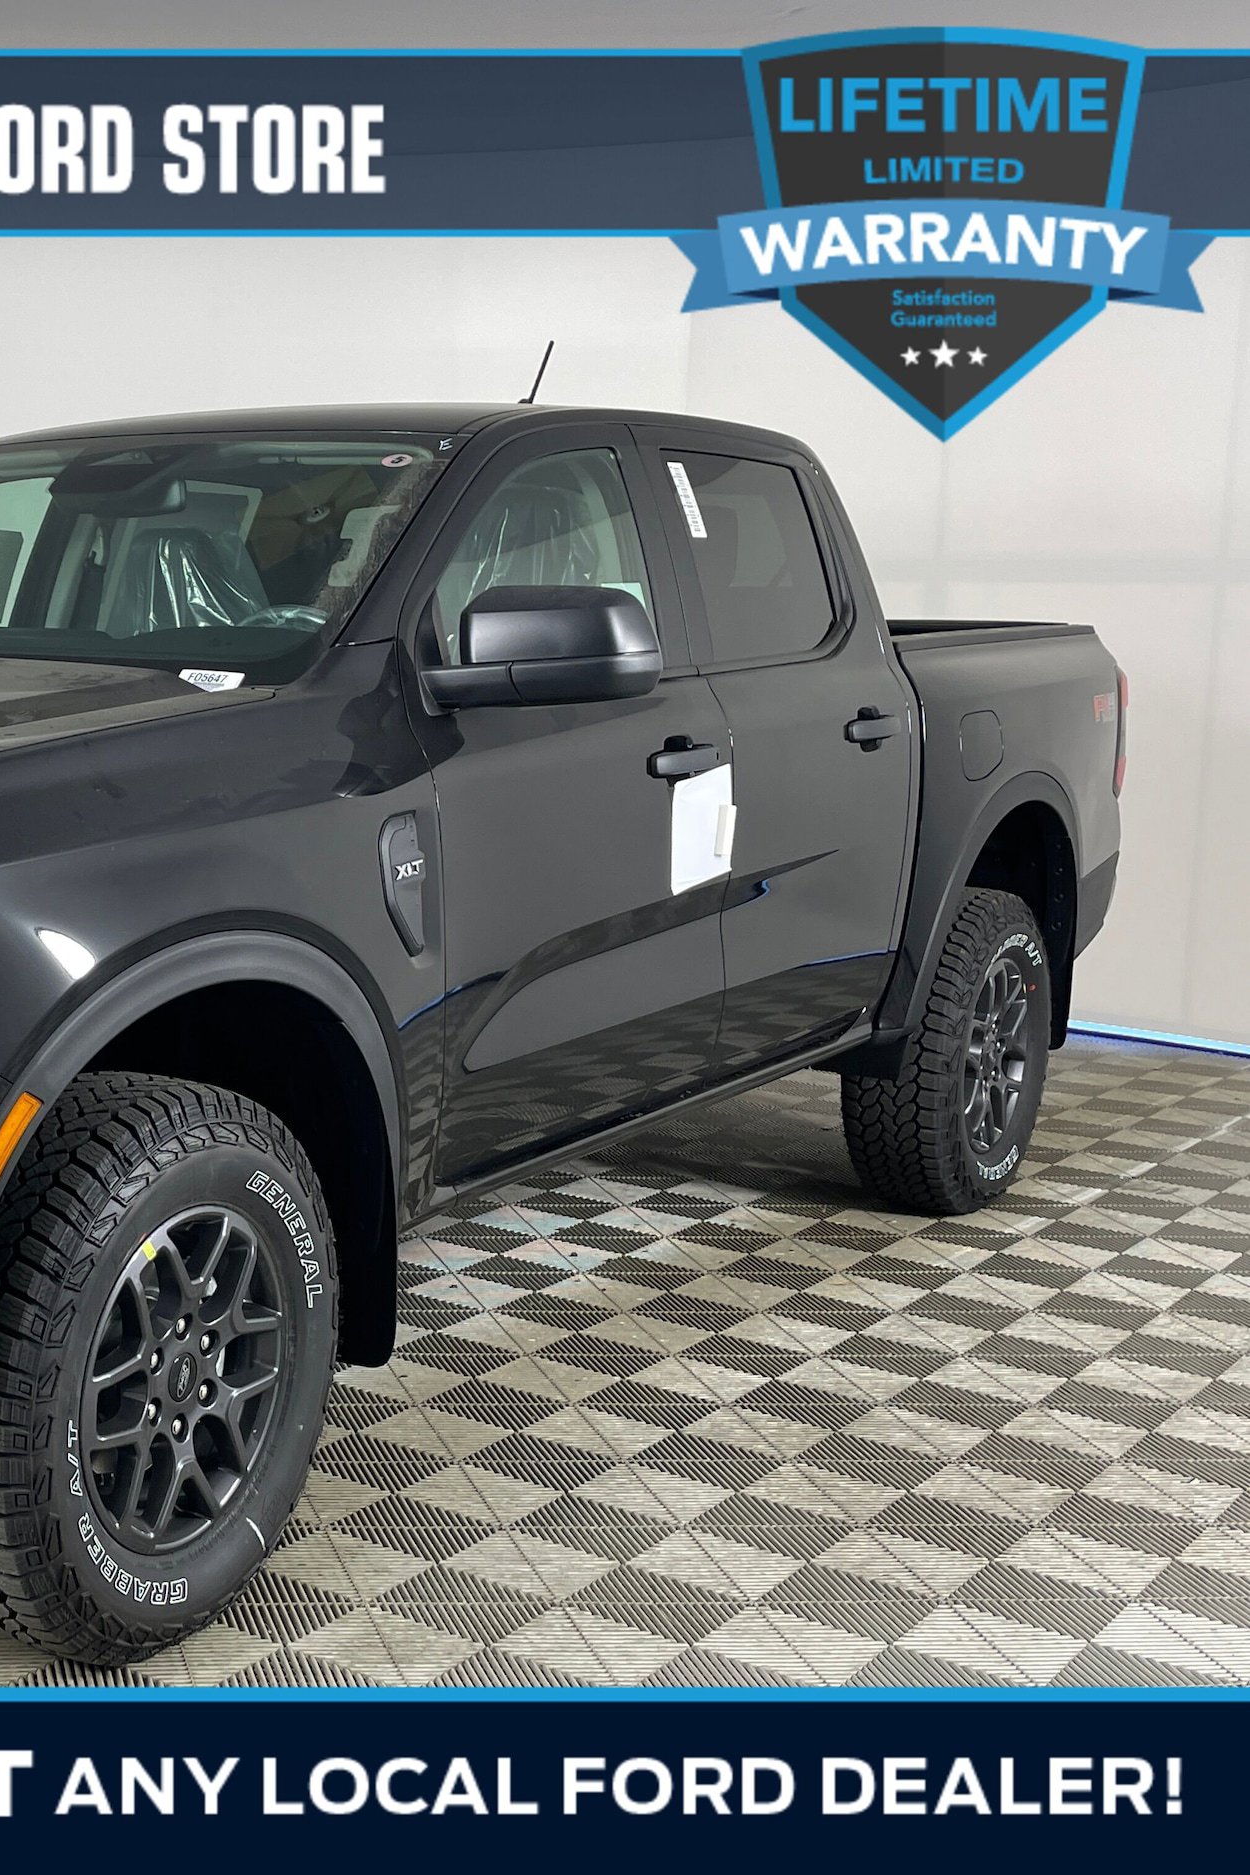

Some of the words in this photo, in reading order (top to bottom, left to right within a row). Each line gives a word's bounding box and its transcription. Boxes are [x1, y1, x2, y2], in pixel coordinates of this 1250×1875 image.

[394, 859, 424, 881] XLT
[245, 1170, 323, 1309] GENERAL
[67, 1419, 84, 1497] A/T
[77, 1512, 190, 1606] GRABBER
